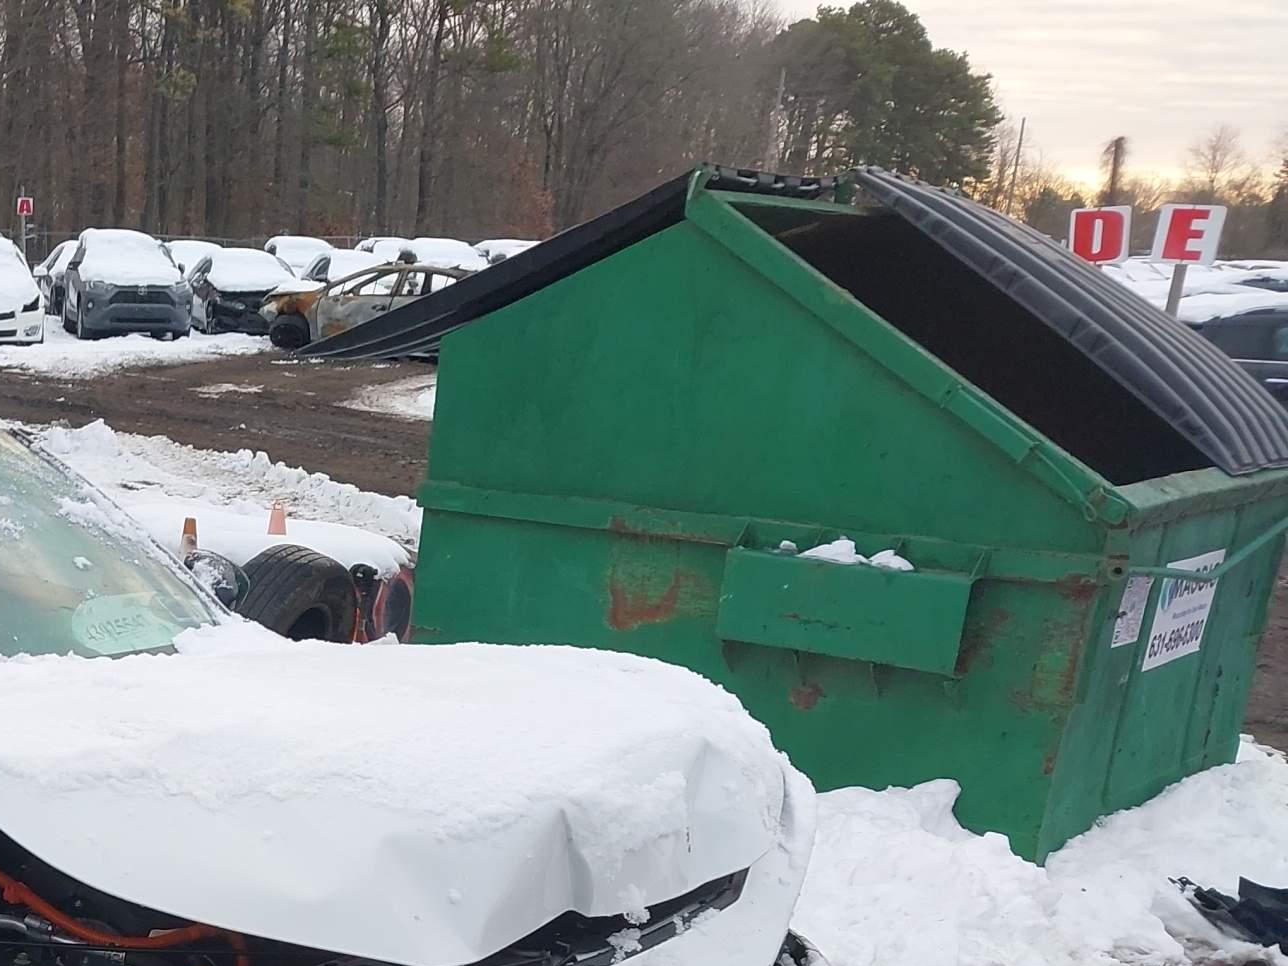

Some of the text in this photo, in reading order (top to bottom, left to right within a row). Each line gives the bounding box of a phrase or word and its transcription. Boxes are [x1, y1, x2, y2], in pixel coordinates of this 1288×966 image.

[19, 200, 31, 213] A
[1073, 210, 1124, 262] D
[1161, 208, 1211, 260] E
